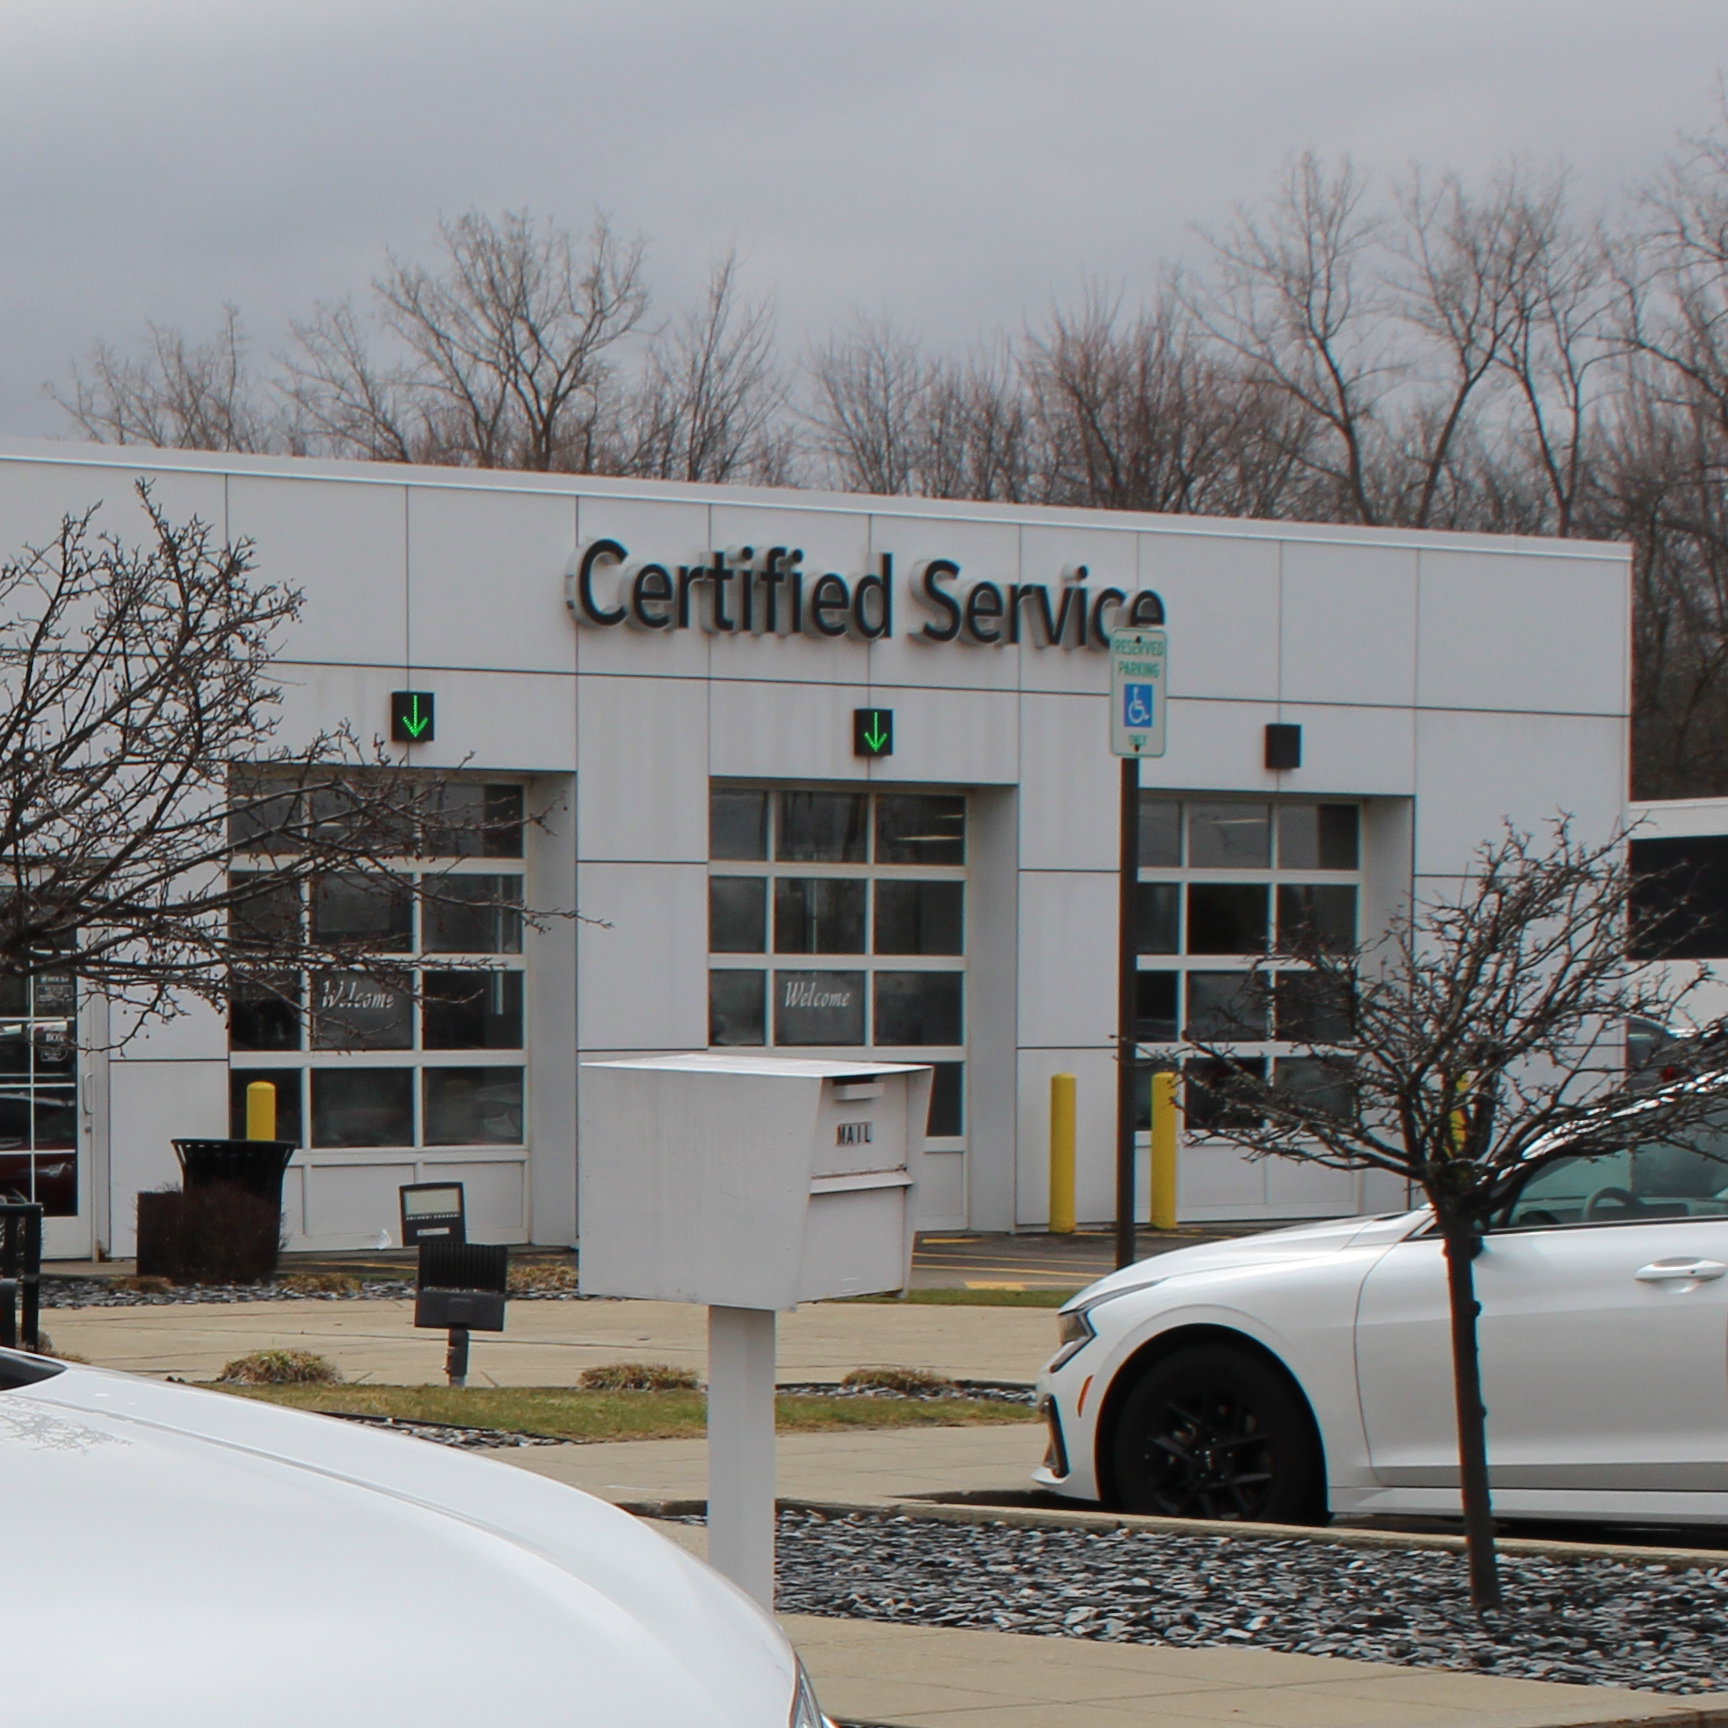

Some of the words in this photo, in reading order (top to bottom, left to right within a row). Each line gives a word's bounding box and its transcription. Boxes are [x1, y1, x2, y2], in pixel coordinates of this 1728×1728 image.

[579, 537, 892, 639] Certified
[922, 558, 1165, 650] Service
[1118, 661, 1160, 678] PARKING
[785, 981, 850, 1007] Welcome
[836, 1123, 872, 1146] MAIL
